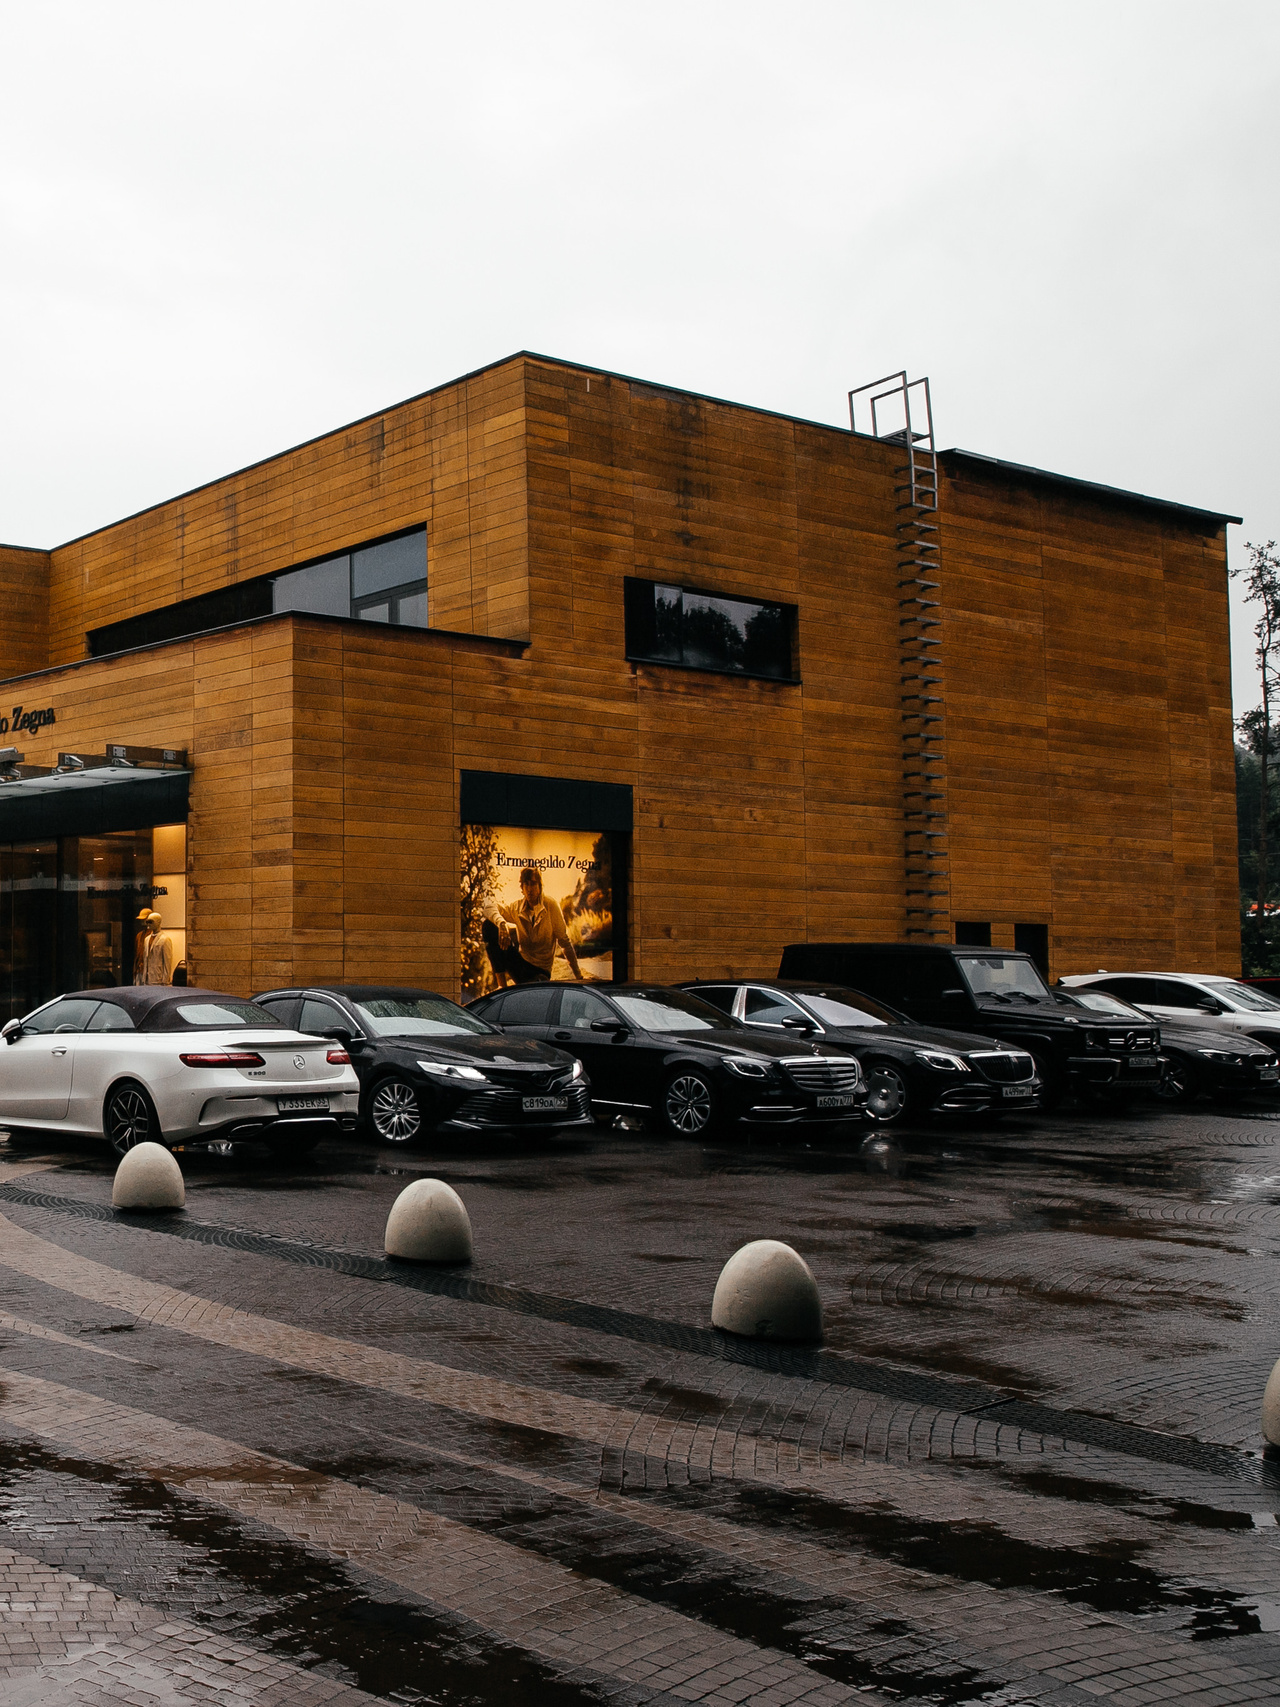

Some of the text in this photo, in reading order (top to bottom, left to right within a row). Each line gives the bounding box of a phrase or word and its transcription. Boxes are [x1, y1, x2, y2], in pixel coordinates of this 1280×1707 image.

[11, 705, 56, 735] Zegna
[495, 852, 602, 874] Ermenegildo Zegna
